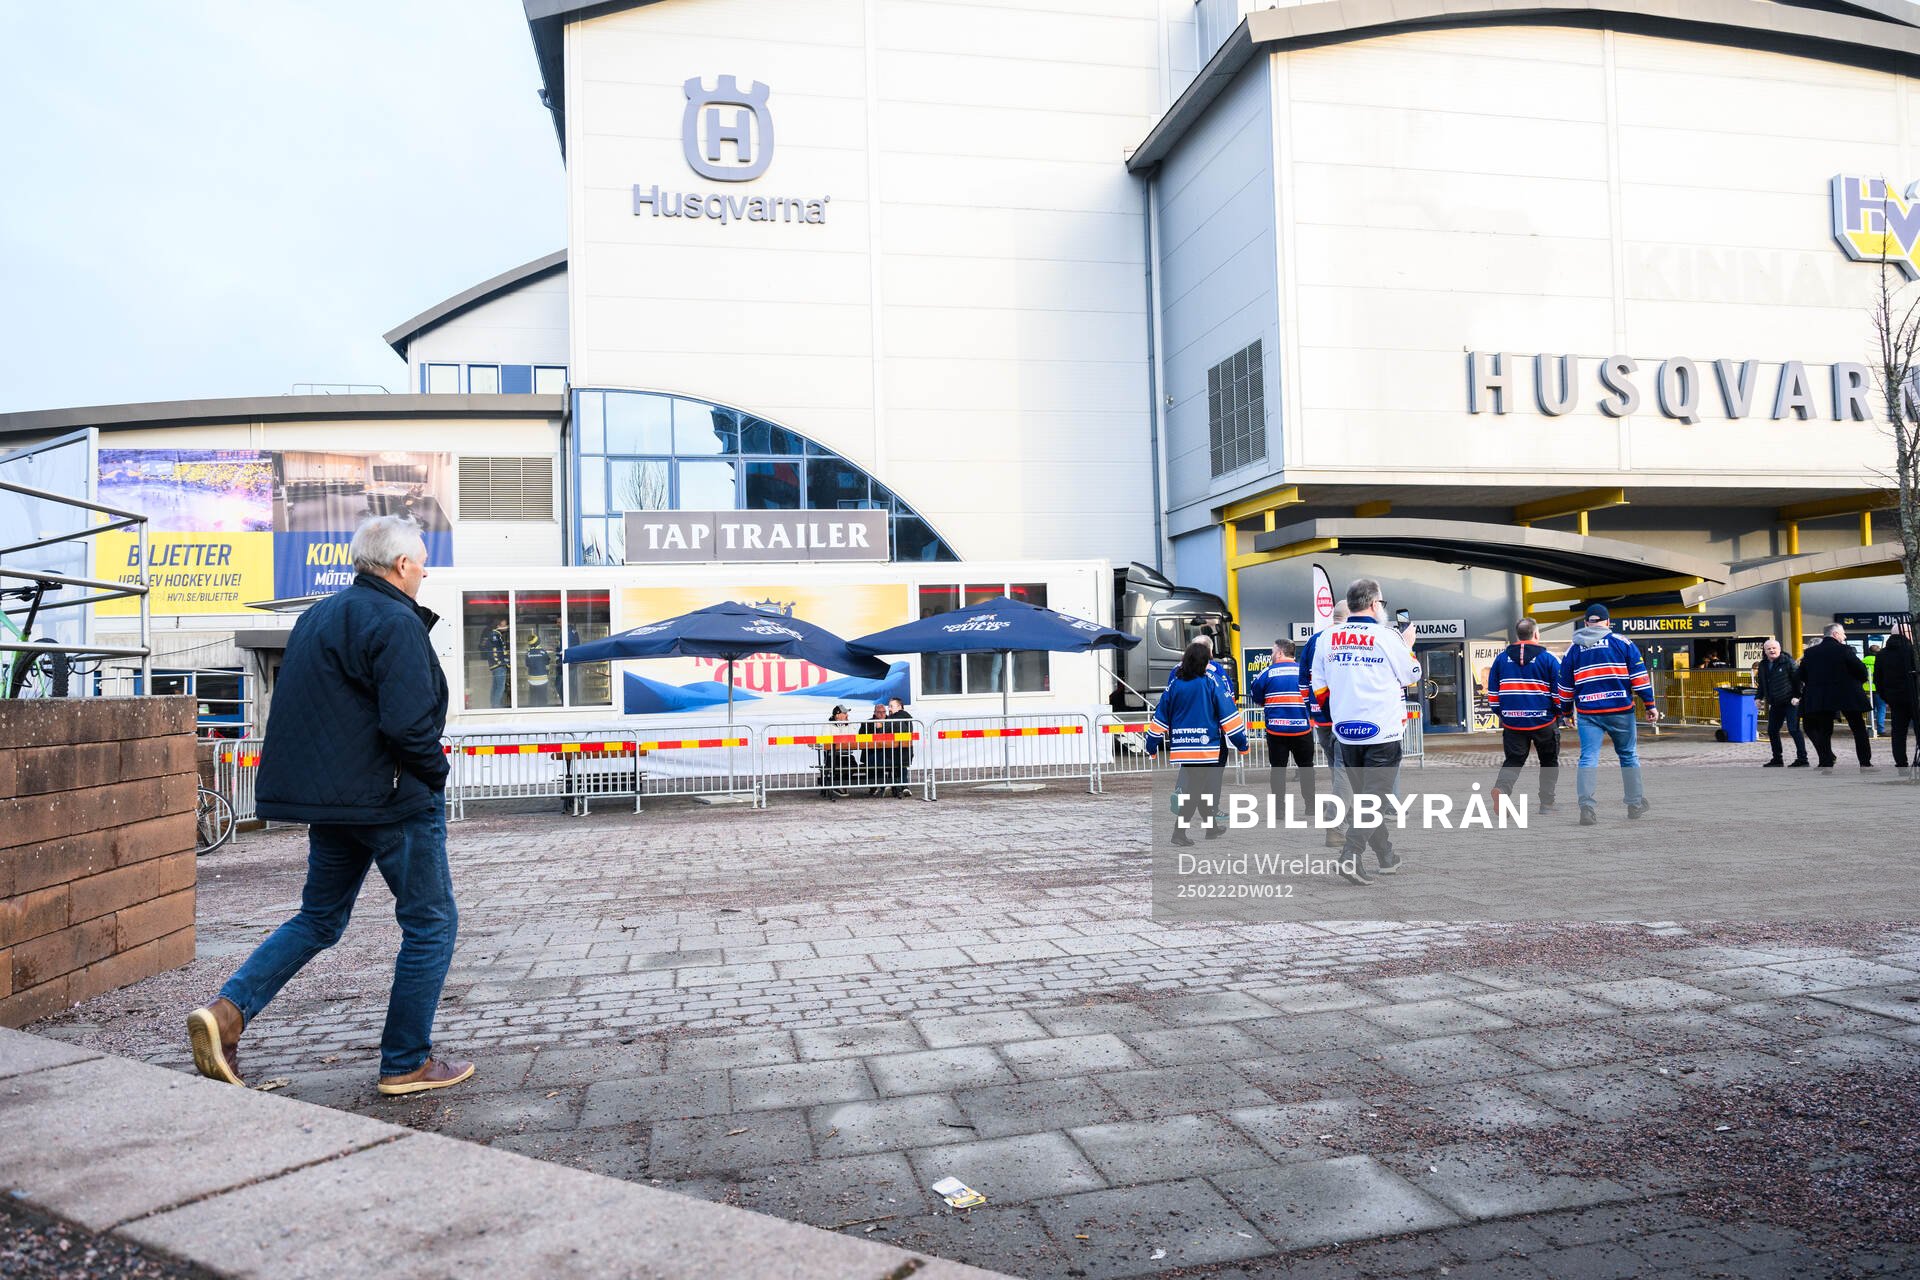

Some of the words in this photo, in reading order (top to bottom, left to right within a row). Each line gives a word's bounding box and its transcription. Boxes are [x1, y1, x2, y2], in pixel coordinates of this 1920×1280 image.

[632, 183, 826, 226] Husqvarna
[643, 523, 711, 550] TAP
[720, 522, 871, 549] TRAILER
[127, 543, 233, 567] BLJETTER
[305, 543, 353, 566] KON
[165, 573, 211, 587] HOCKEY
[213, 573, 242, 587] LIVE!
[1622, 616, 1693, 631] PUBLIKENTRÉ
[1331, 631, 1375, 647] MAXI
[1354, 656, 1385, 664] CARGO
[1475, 648, 1492, 659] HEJA
[714, 660, 828, 693] GULD
[1585, 691, 1626, 701] INTERSPORT
[1339, 724, 1373, 735] Carrier
